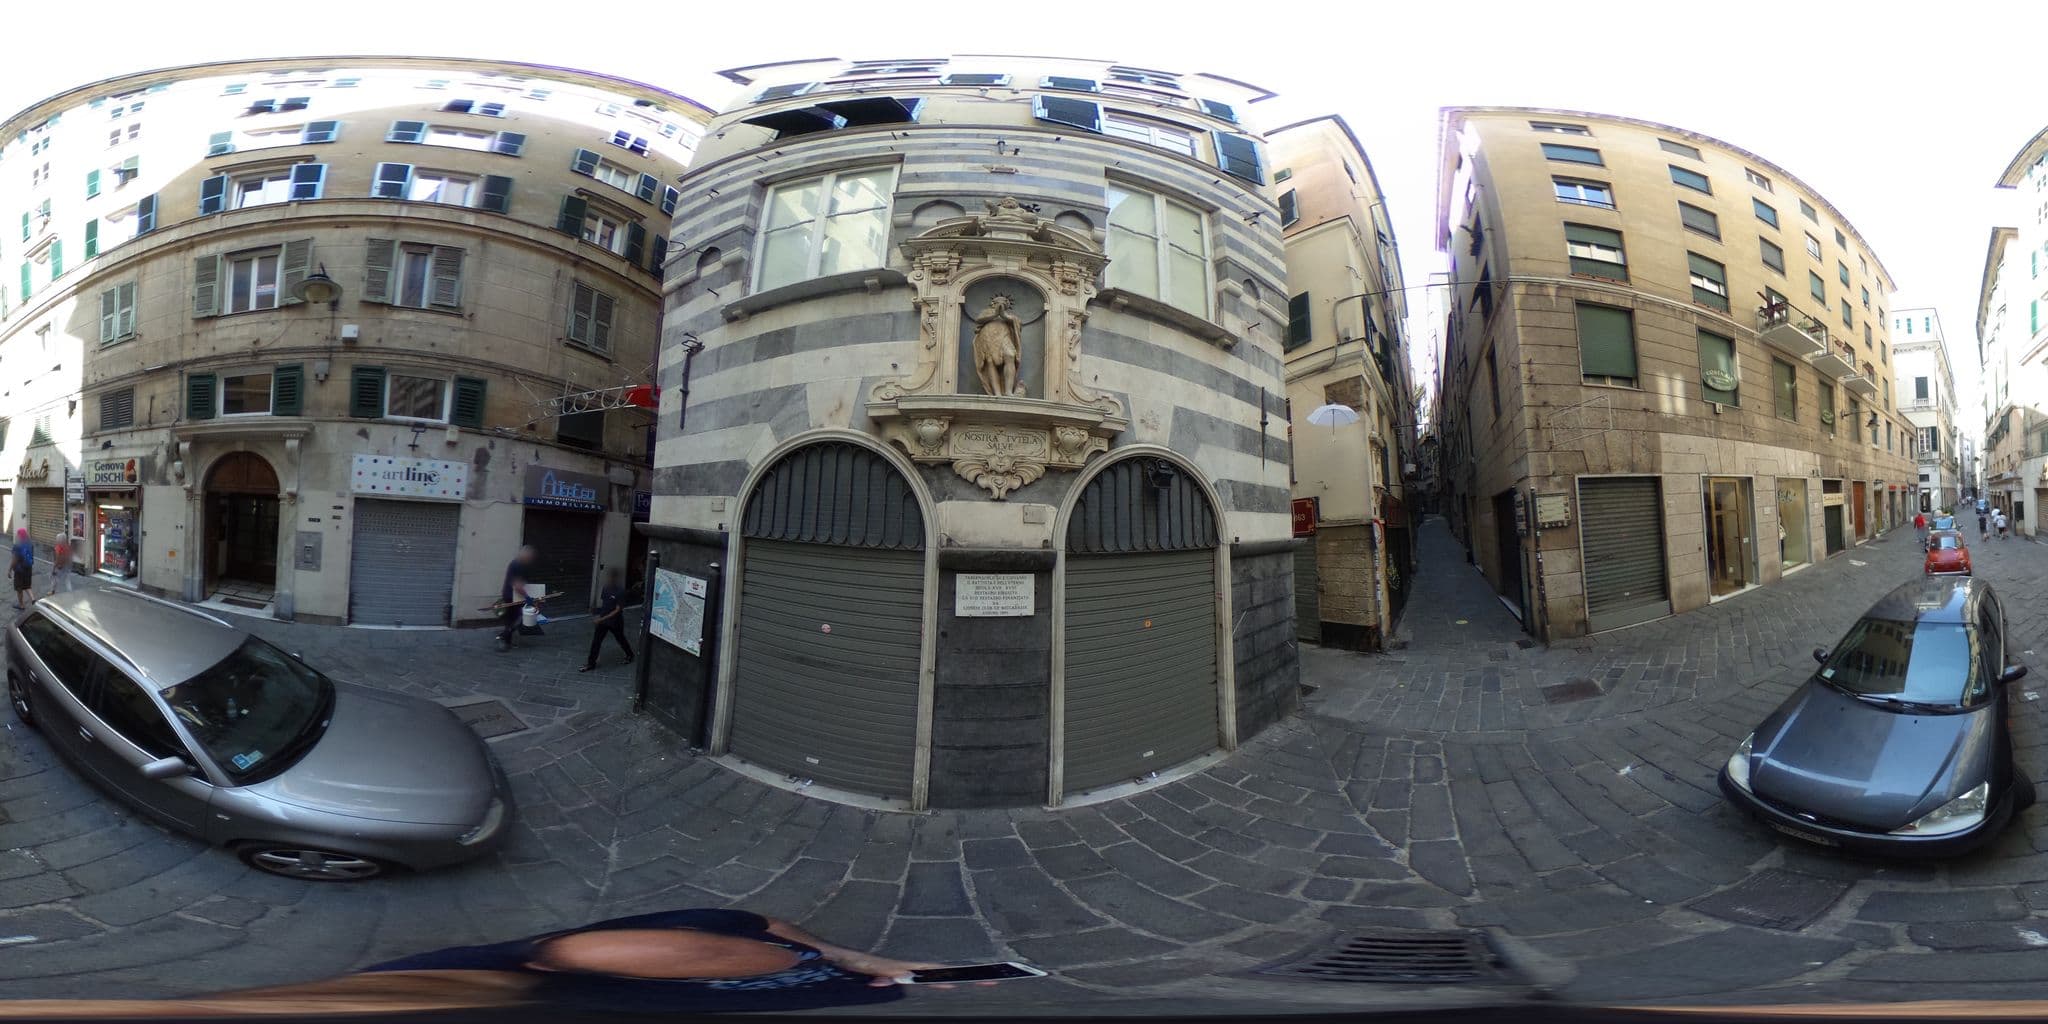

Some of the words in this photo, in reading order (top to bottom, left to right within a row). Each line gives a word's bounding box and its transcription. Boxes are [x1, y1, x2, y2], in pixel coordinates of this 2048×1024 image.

[964, 432, 998, 442] NOSTRA
[1007, 435, 1038, 444] TVTELA
[987, 442, 1014, 450] SALVE
[94, 461, 125, 471] Genova
[94, 473, 124, 482] DISCHI
[382, 466, 440, 485] artline
